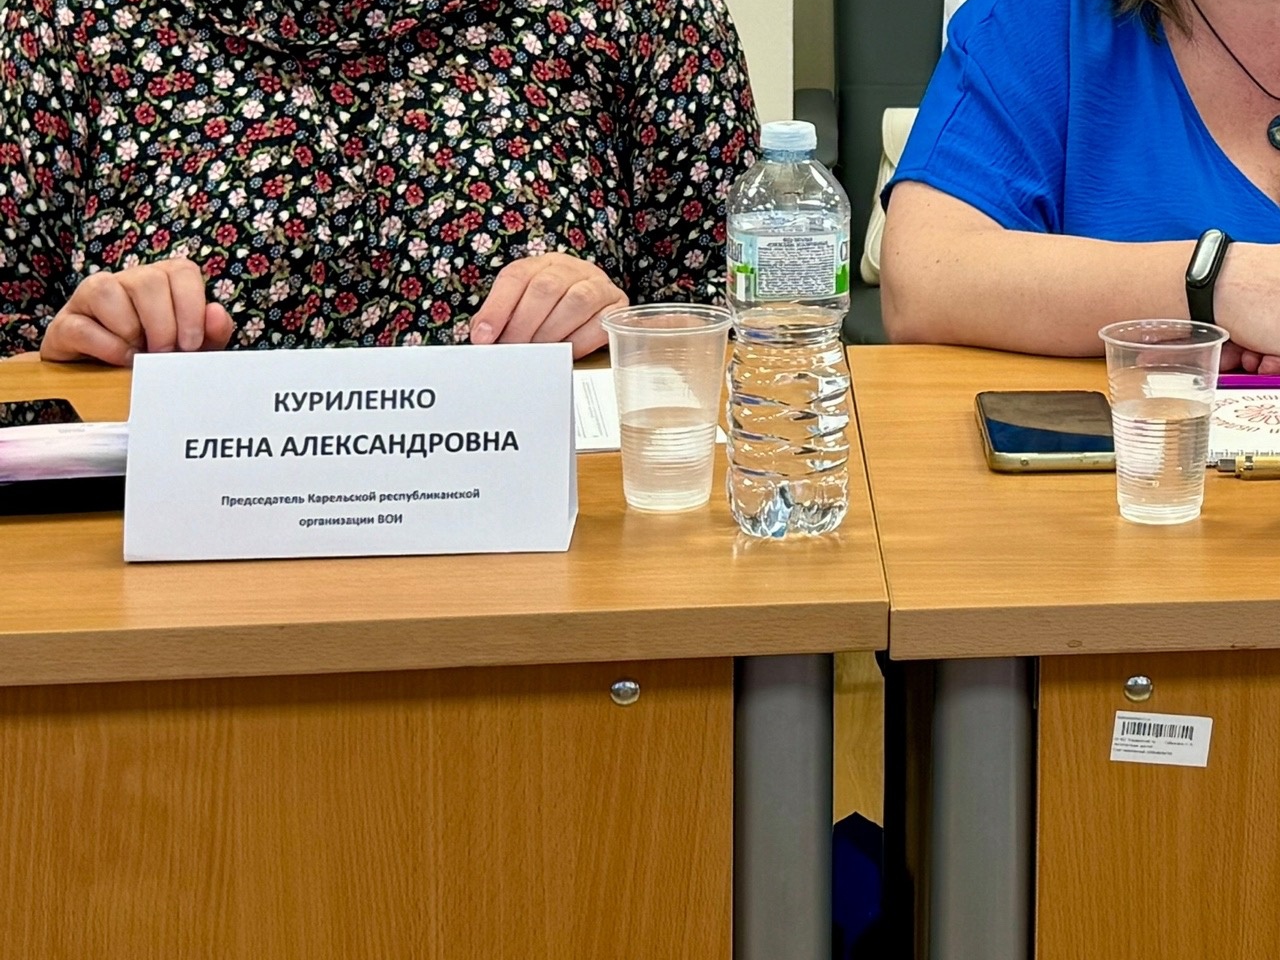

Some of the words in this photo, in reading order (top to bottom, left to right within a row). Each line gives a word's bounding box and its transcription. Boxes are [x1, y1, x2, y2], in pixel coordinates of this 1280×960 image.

[274, 388, 436, 413] КУРИЛЕНКО
[185, 437, 273, 459] ЕЛЕНА
[280, 430, 520, 459] АЛЕКСАНДРОВНА
[221, 494, 305, 508] Председатель
[307, 491, 377, 506] Карельской
[379, 488, 480, 506] республиканской
[298, 515, 375, 529] организации
[377, 513, 403, 525] ВОИ
